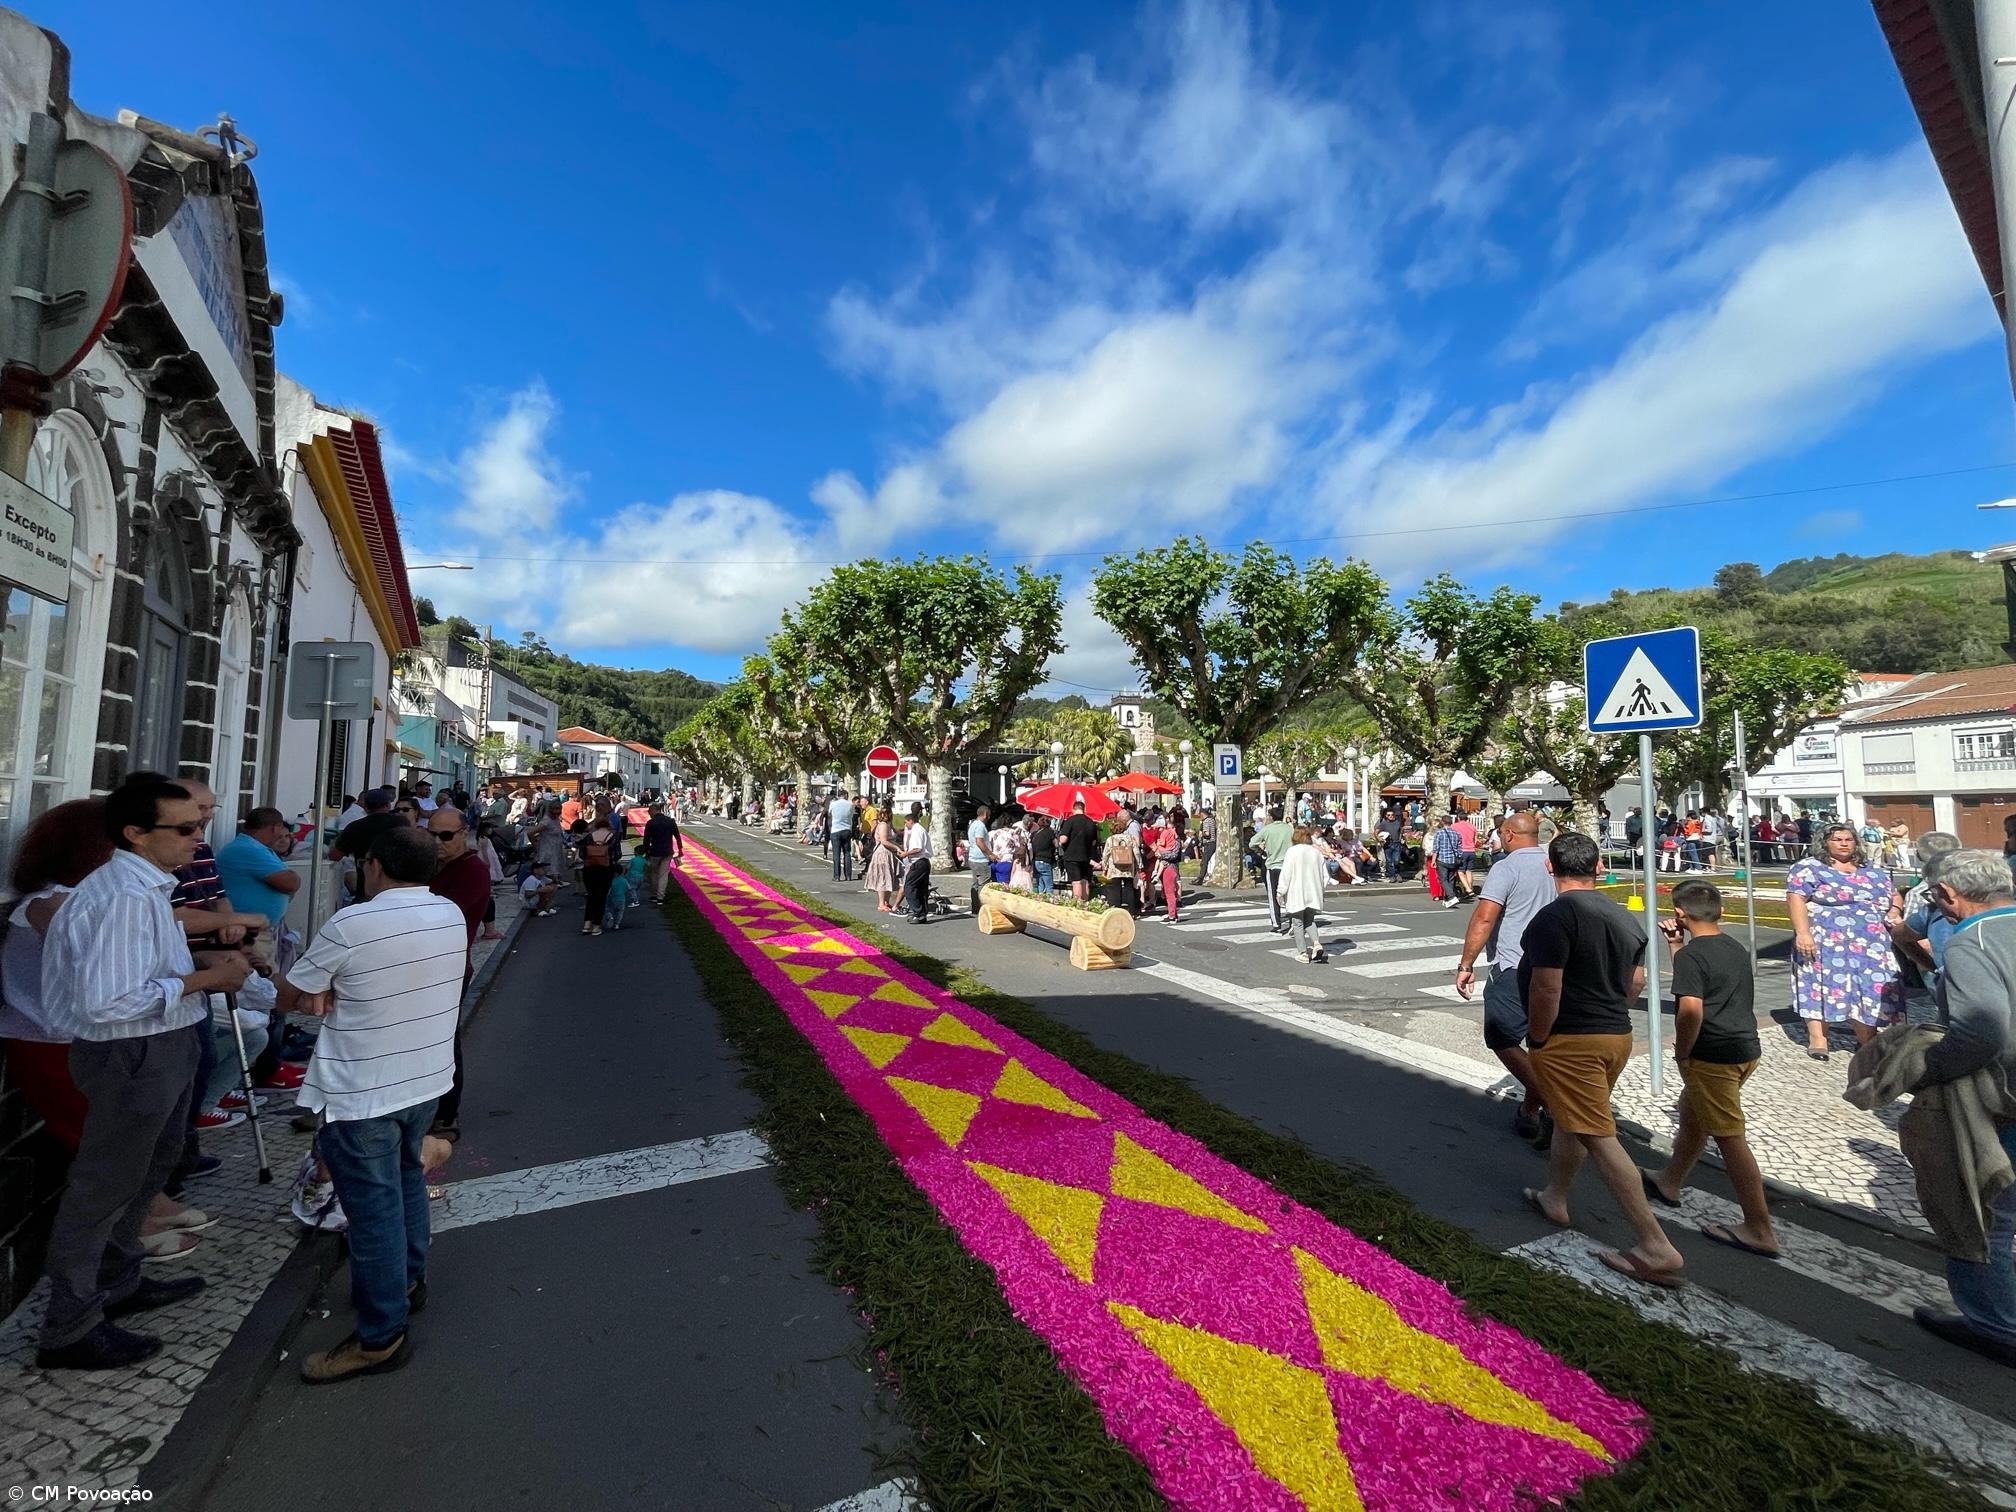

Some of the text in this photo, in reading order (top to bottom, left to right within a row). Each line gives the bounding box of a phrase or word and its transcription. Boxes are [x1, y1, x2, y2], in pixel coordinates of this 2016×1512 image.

[5, 504, 56, 543] Excepto
[6, 531, 34, 552] 18H30
[1223, 757, 1234, 774] P
